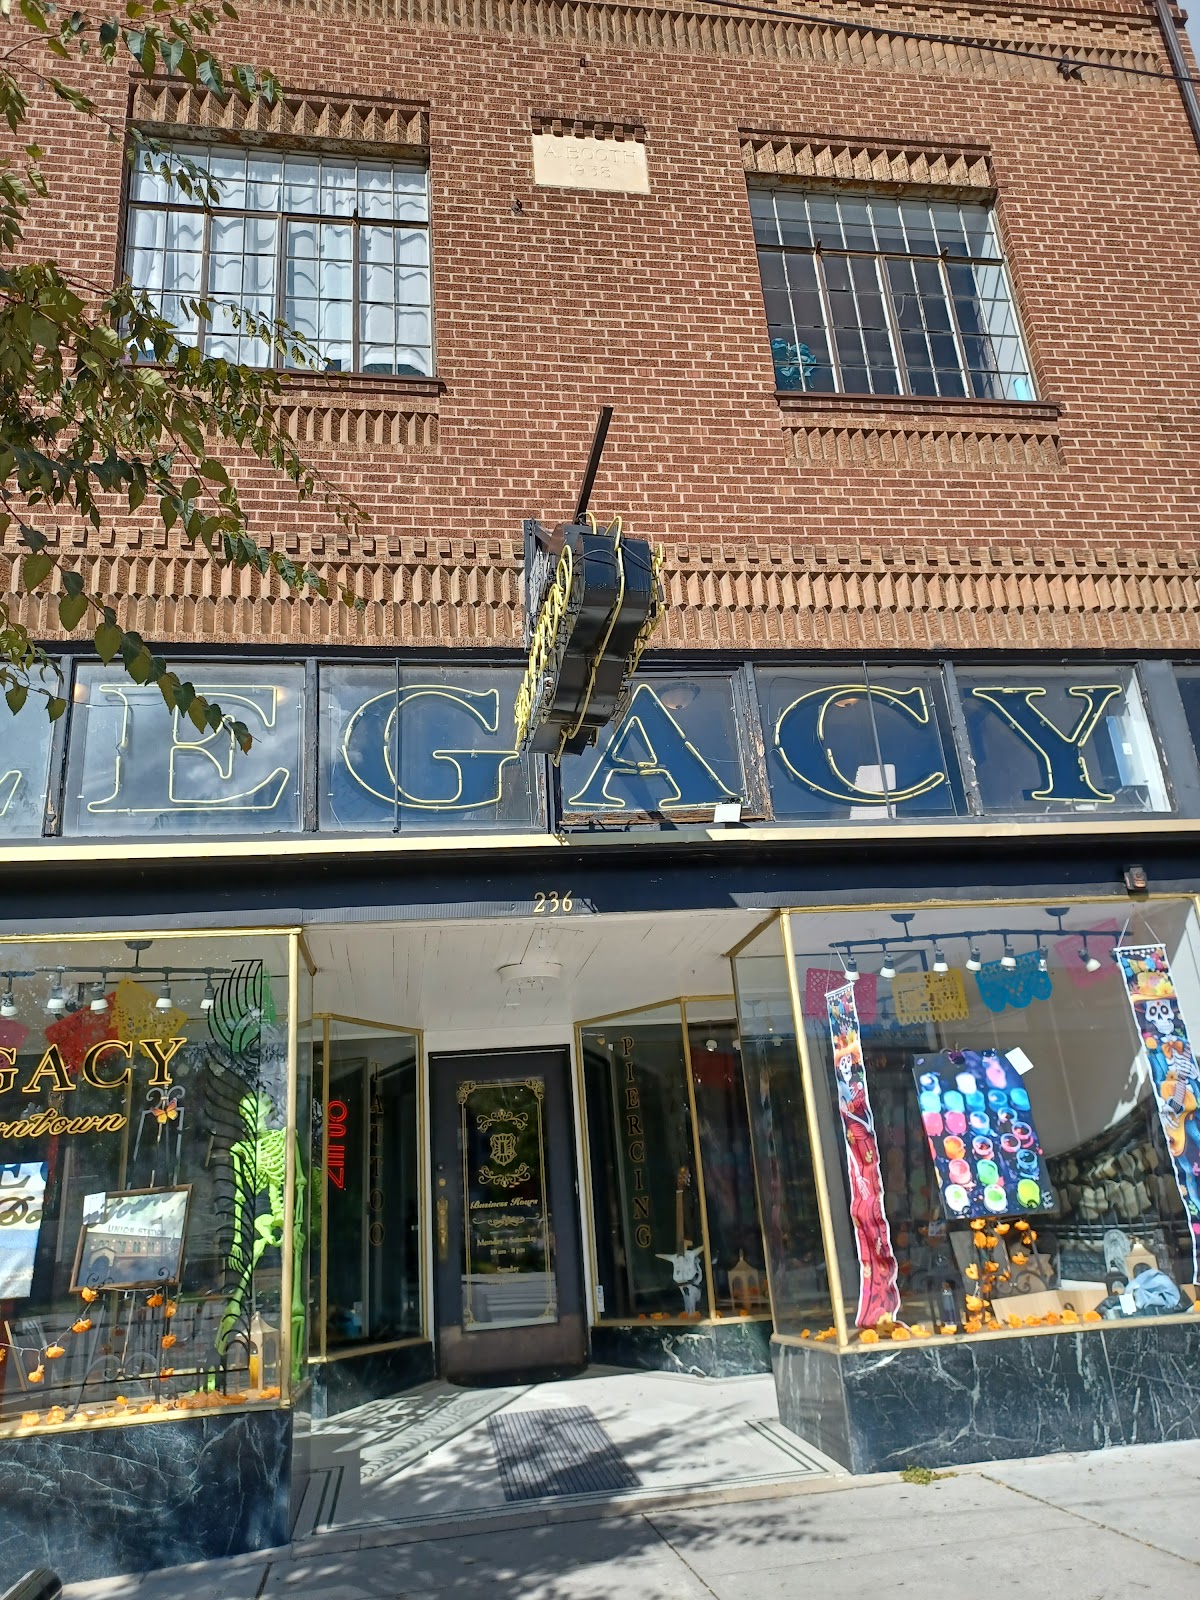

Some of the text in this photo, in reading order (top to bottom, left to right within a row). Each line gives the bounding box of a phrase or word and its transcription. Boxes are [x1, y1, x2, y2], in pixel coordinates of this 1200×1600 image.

[566, 147, 637, 164] BOOTH
[0, 683, 1123, 816] EGACY
[533, 889, 573, 913] 236
[620, 1035, 653, 1249] PIERCING
[368, 1061, 386, 1247] TATTOO
[470, 1197, 538, 1210] Business Hours
[107, 1224, 135, 1234] UNION
[477, 1238, 503, 1247] Monday
[496, 1265, 520, 1274] Sunday
